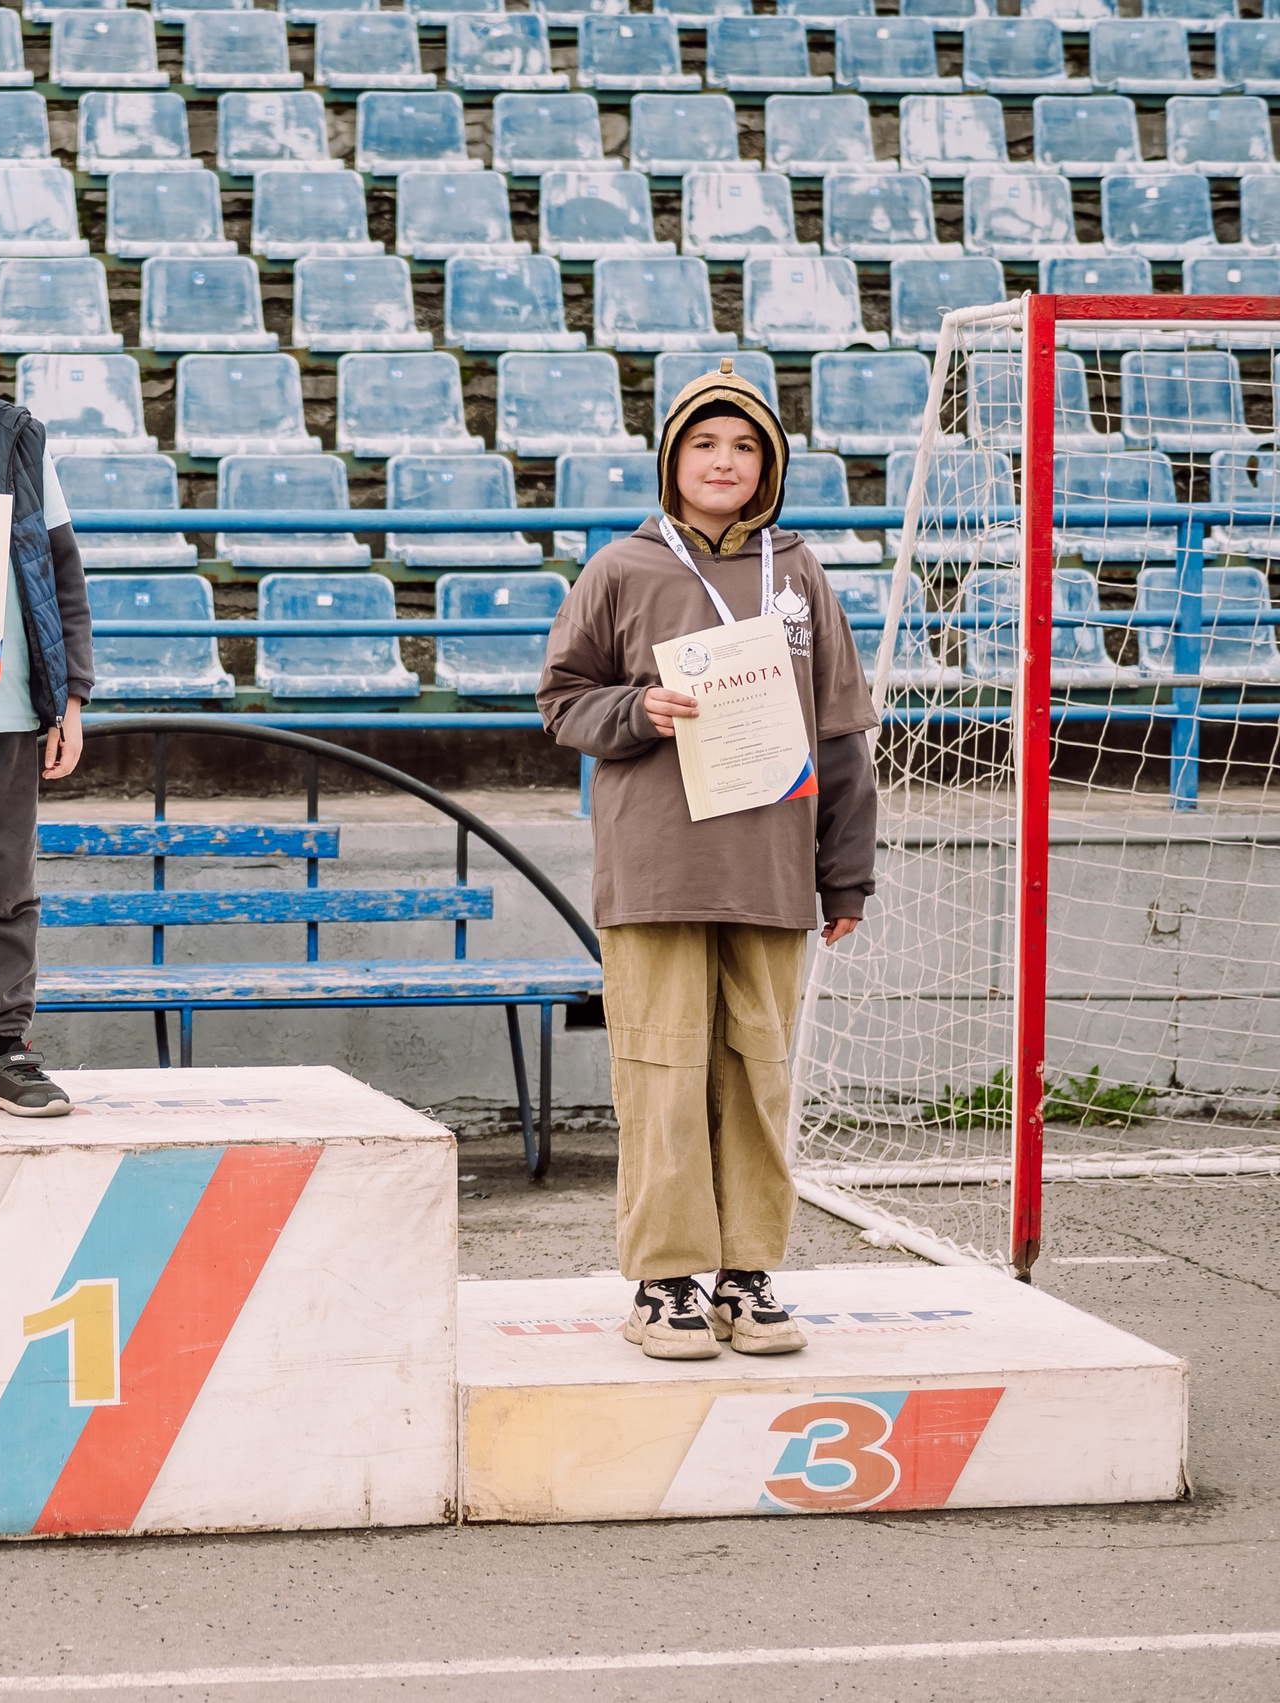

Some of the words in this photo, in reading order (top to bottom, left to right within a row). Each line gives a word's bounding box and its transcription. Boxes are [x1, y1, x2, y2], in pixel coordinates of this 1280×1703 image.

[691, 665, 782, 697] ГРАМОТА
[23, 1278, 120, 1407] 1
[814, 1324, 972, 1336] СТАДИОН
[764, 1396, 901, 1509] 3
